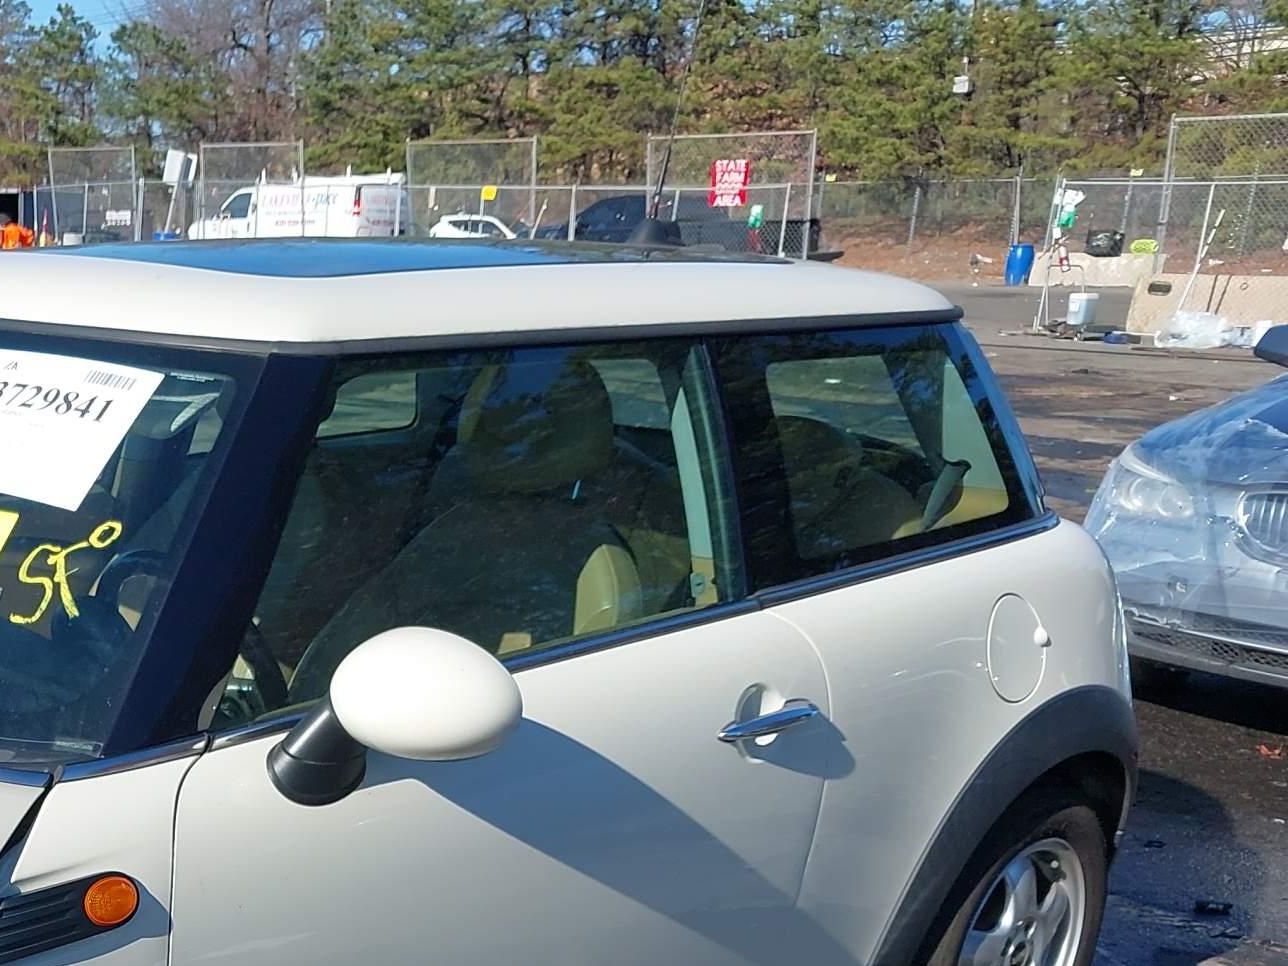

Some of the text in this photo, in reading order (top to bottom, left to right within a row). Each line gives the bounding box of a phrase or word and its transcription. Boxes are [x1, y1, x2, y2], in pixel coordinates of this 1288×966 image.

[715, 159, 747, 171] STATE
[715, 171, 745, 183] FARM
[713, 194, 742, 206] AREA
